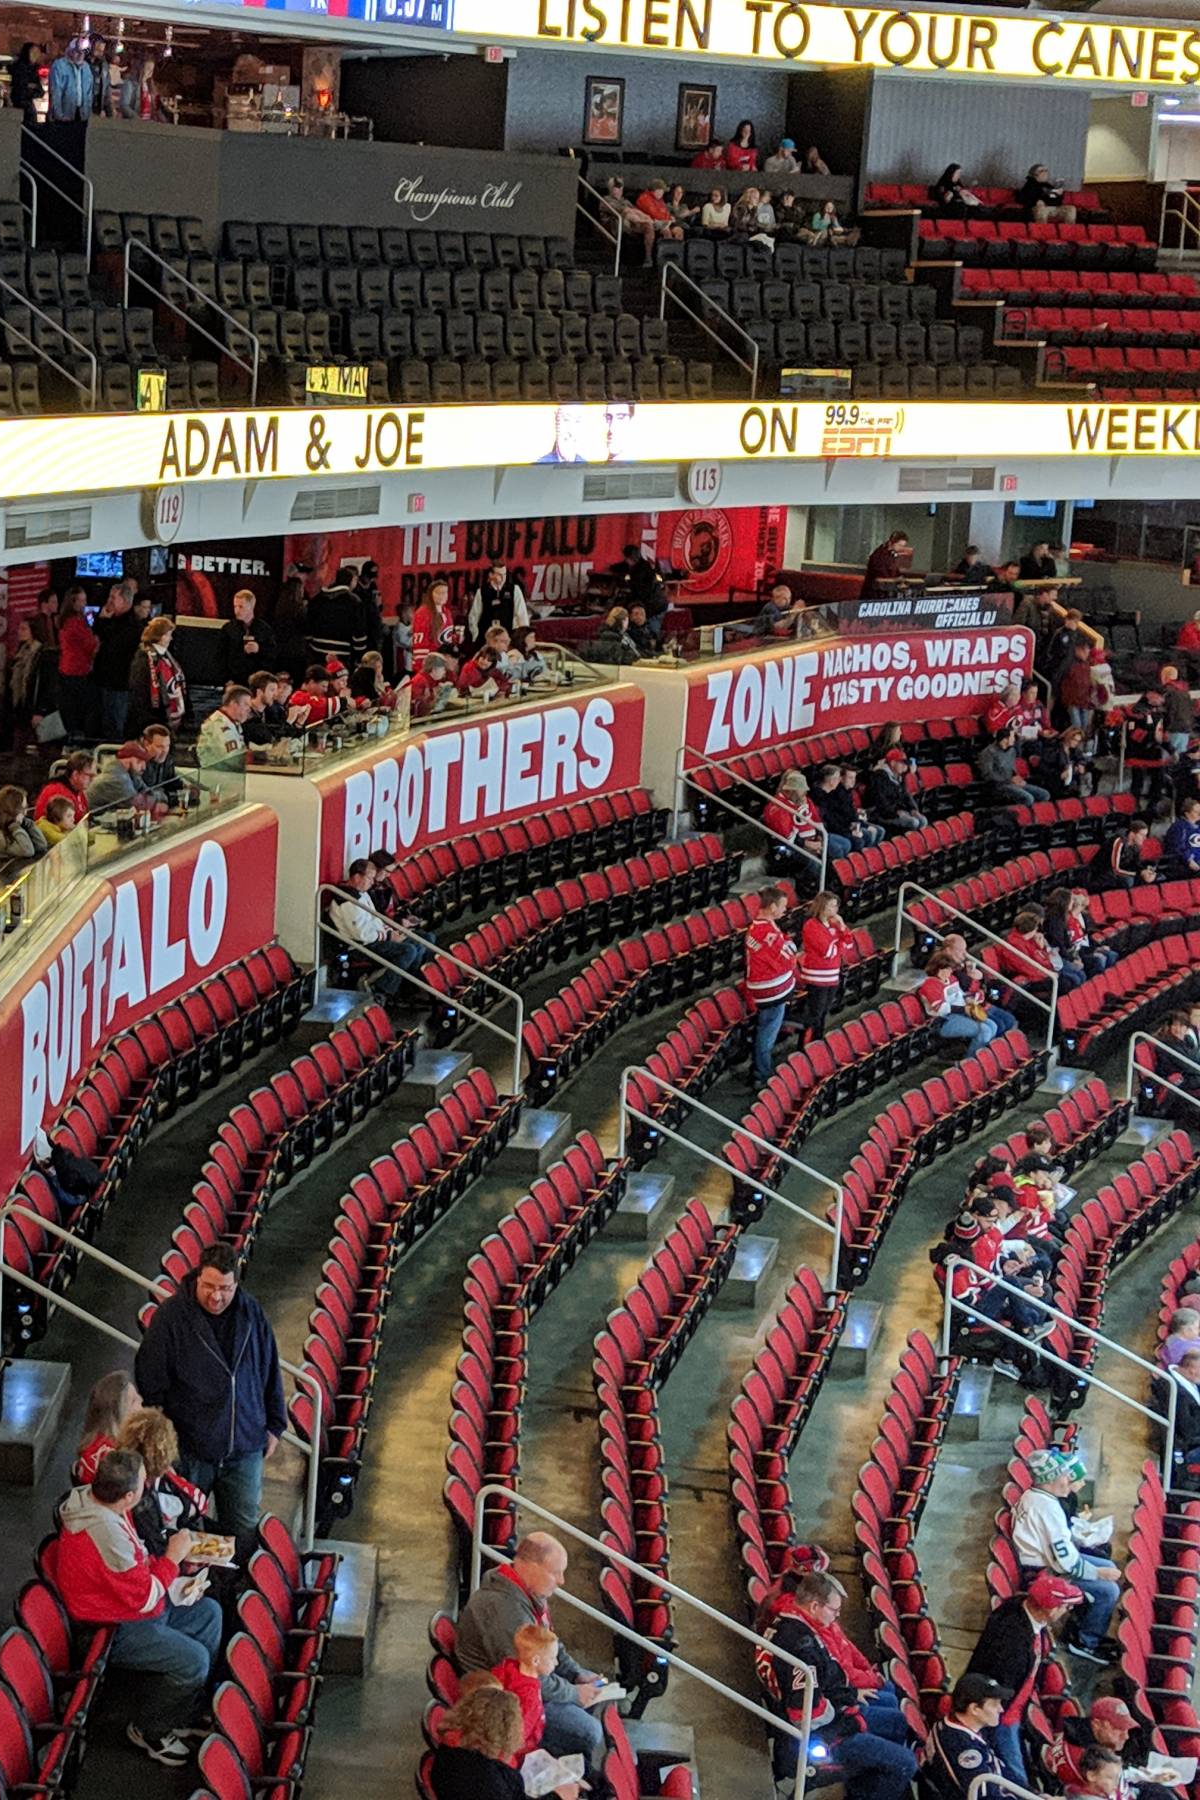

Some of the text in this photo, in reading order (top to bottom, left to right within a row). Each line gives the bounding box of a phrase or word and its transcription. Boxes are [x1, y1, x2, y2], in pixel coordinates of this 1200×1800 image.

[538, 0, 1200, 84] LISTEN TO YOUR CANES
[394, 175, 523, 222] Champions Club
[825, 405, 860, 426] 99.9
[1066, 408, 1200, 450] WEEK
[159, 416, 279, 479] ADAM
[305, 414, 332, 470] &
[354, 412, 426, 468] JOE
[739, 406, 798, 455] ON
[695, 468, 717, 491] 113
[160, 495, 179, 524] 112
[400, 521, 458, 566] THE
[465, 514, 597, 561] BUFFALO
[191, 553, 271, 577] BETTER.
[858, 597, 981, 618] CAROLINA HURRICANES
[935, 611, 997, 628] OFFICIAL DJ
[822, 634, 1027, 680] NACHOS, WRAPS
[704, 651, 819, 755] ZONE
[896, 669, 1025, 701] GOODNESS
[343, 698, 615, 880] BROTHERS
[21, 839, 228, 1156] BUFFALO
